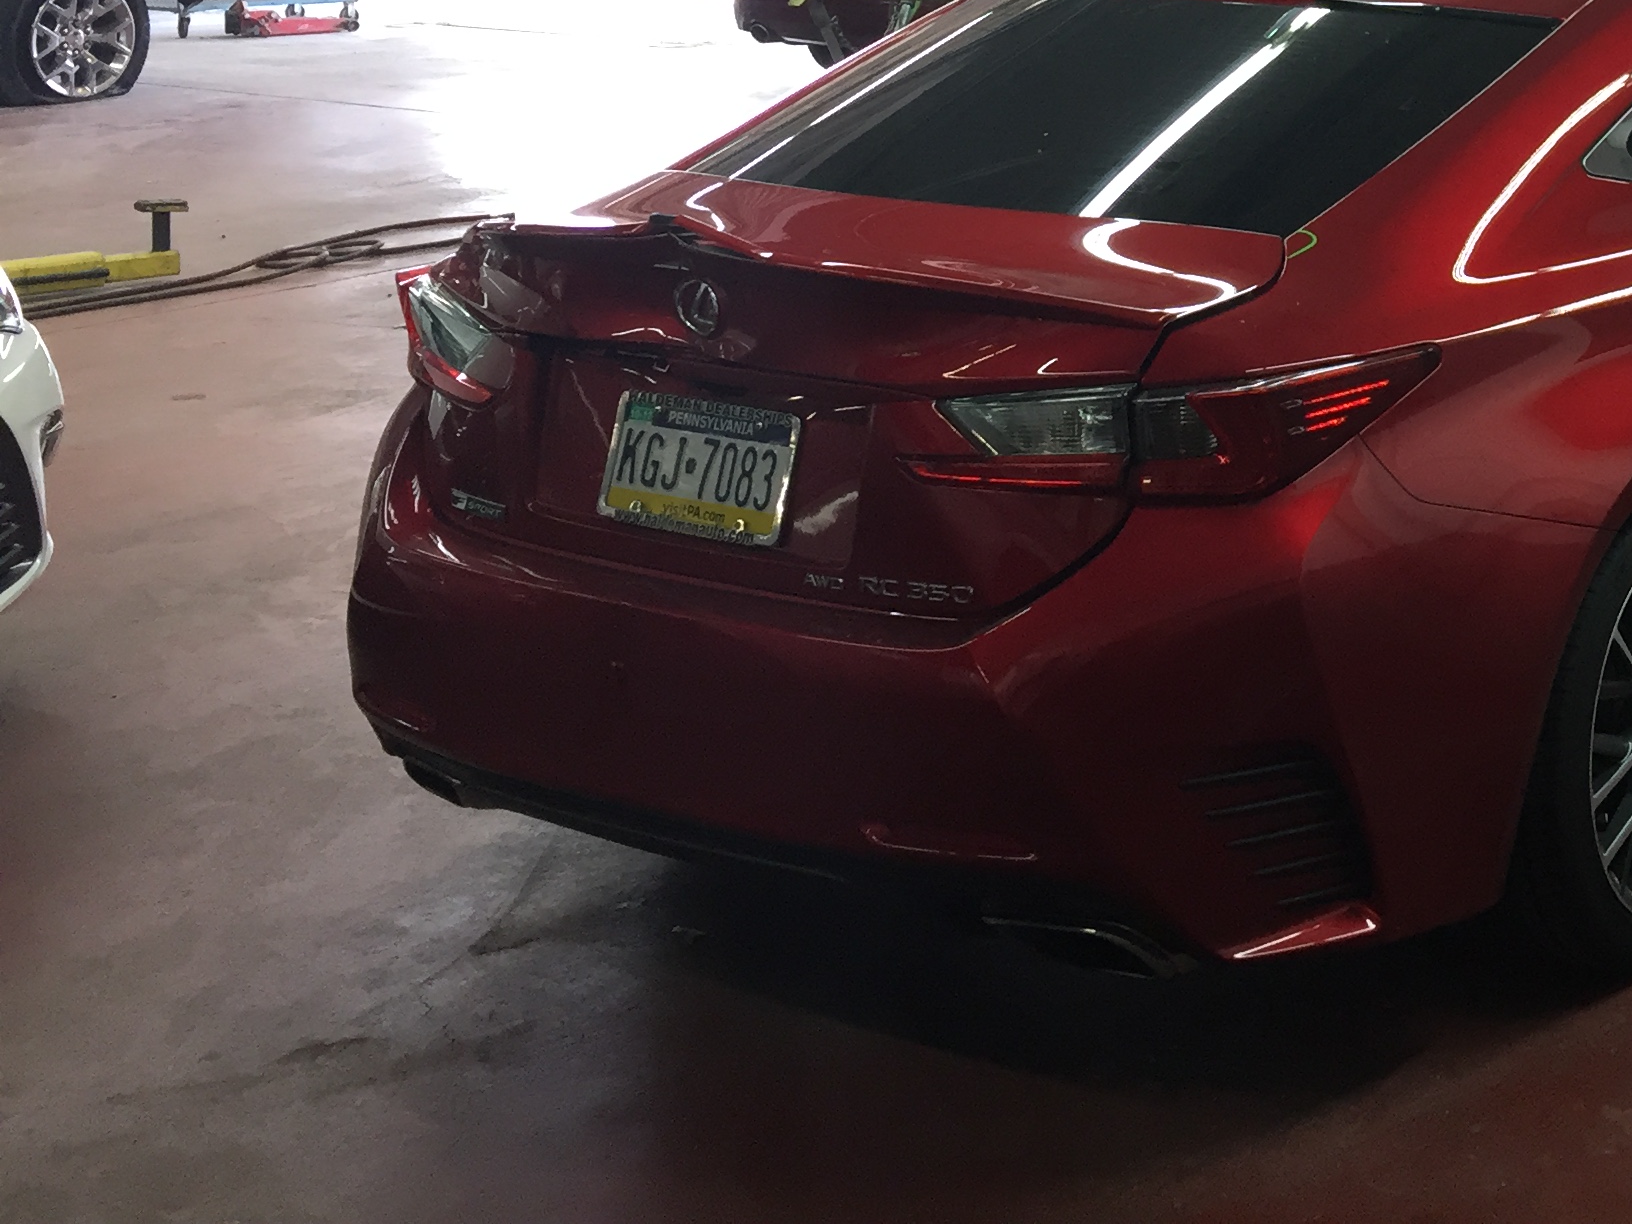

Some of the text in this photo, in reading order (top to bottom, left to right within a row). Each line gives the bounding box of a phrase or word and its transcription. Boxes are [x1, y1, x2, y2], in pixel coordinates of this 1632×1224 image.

[629, 389, 792, 426] HALDEMAN DEALERSHIPS
[668, 410, 754, 436] PENNSYLVANIA
[859, 576, 899, 597] RC
[907, 581, 974, 604] 350
